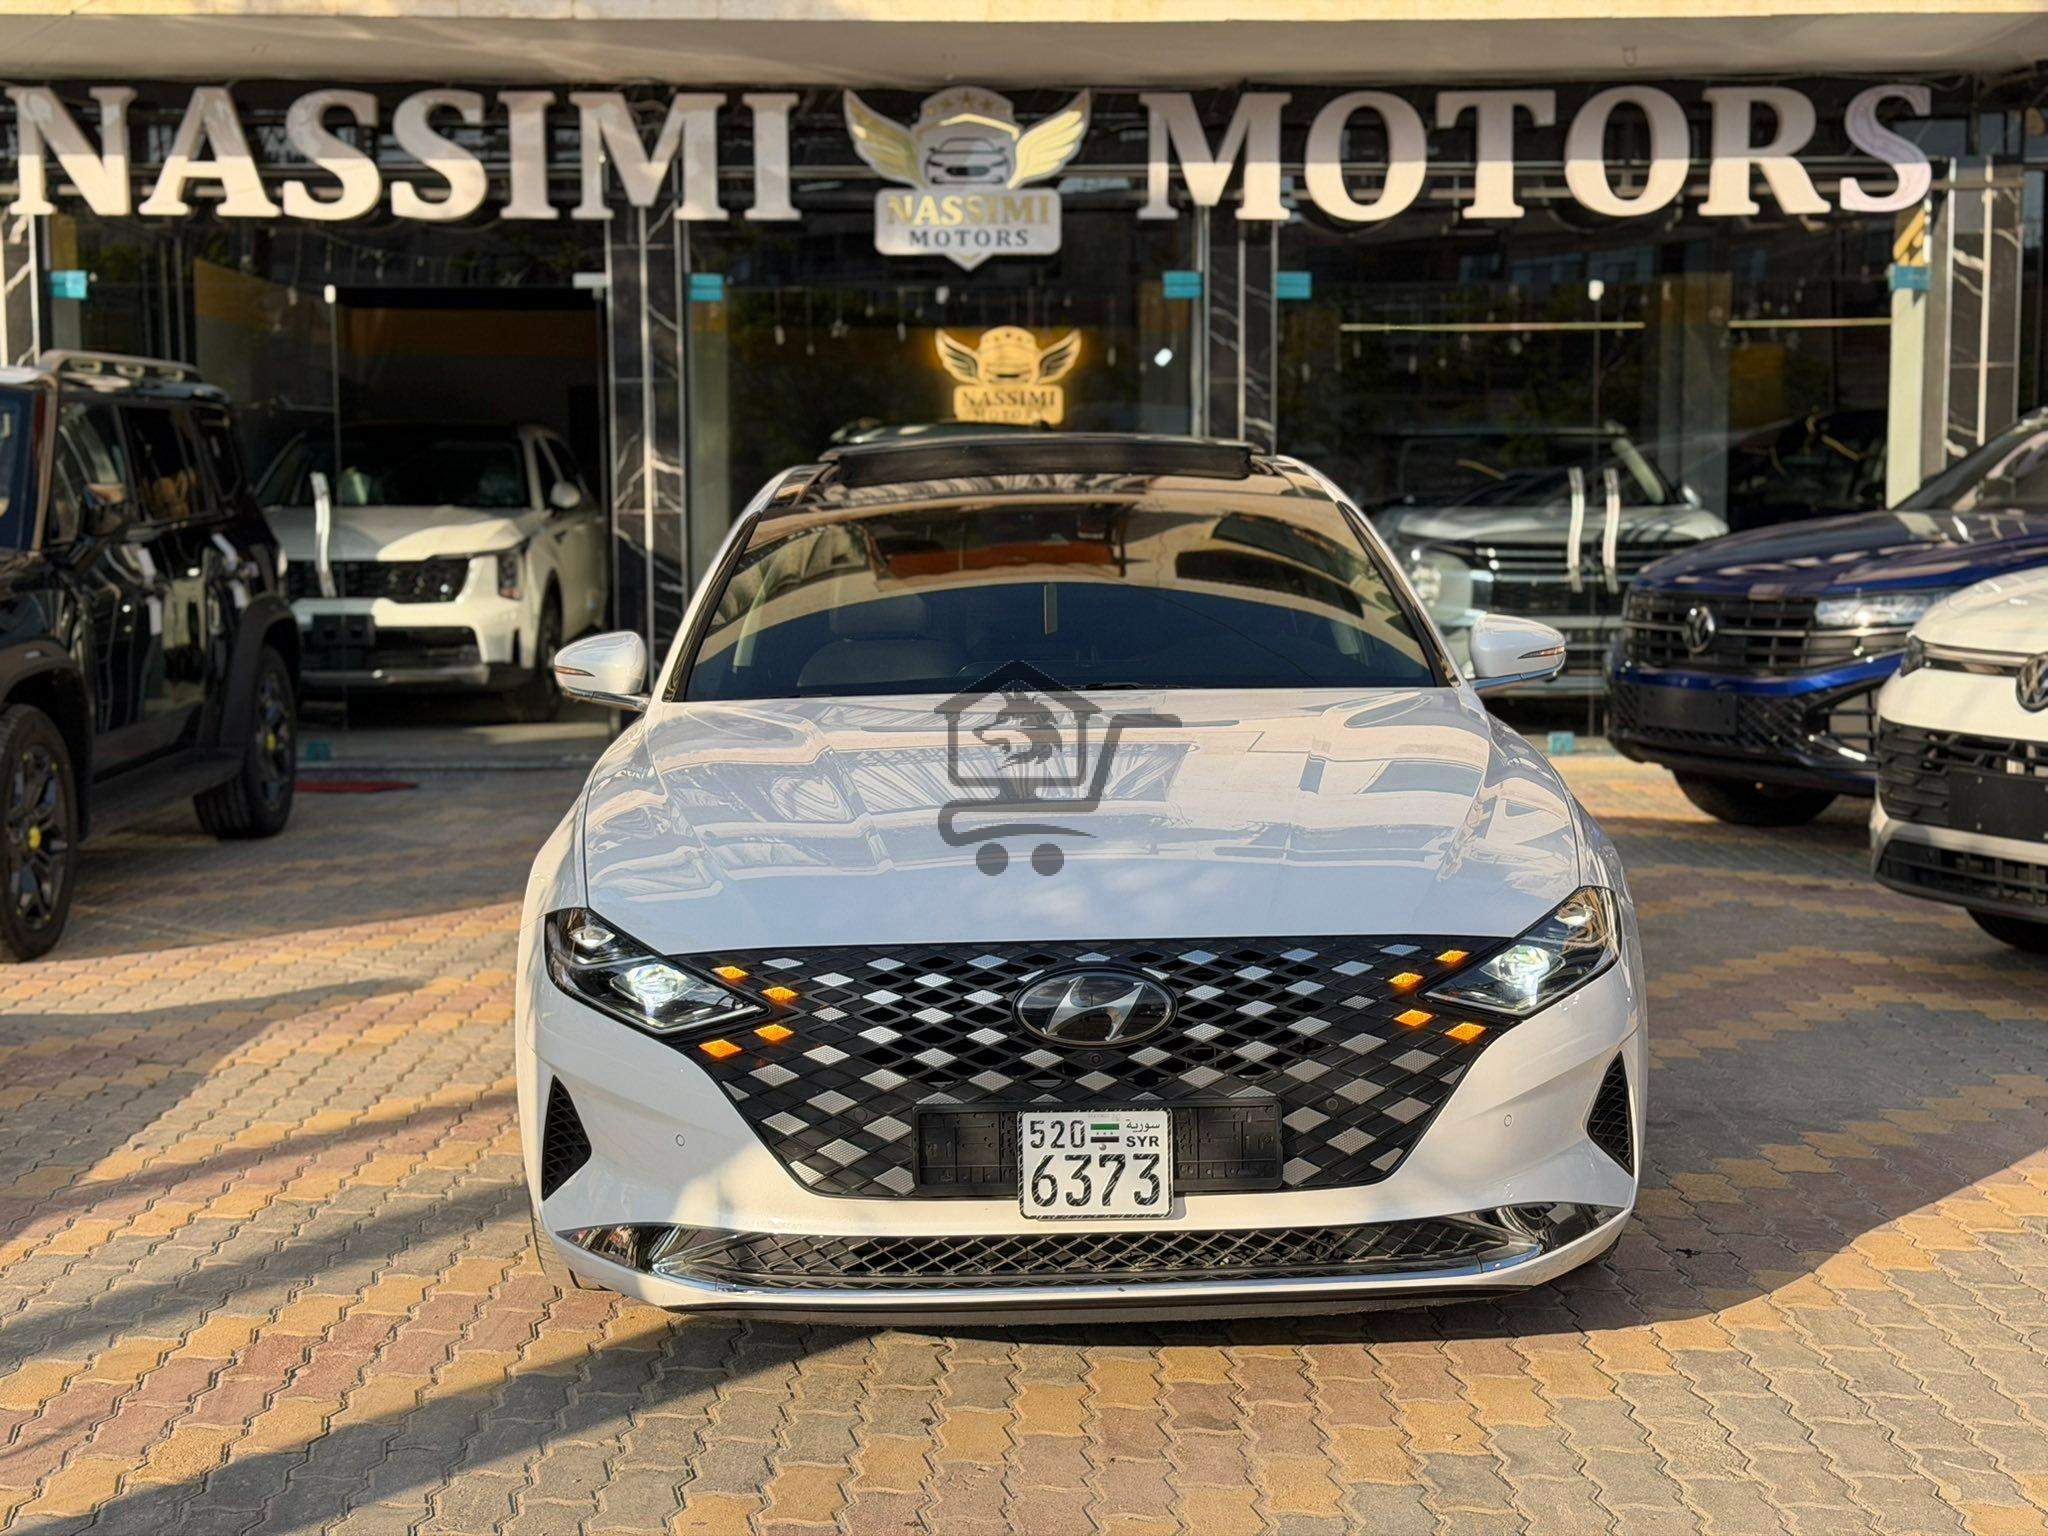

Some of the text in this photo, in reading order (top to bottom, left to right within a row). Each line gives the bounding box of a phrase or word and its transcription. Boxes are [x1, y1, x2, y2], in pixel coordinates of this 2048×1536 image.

[4, 84, 1934, 223] NASSIMI MOTORS
[885, 194, 1052, 227] NASSIMI
[908, 228, 1030, 249] MOTORS
[962, 391, 1056, 407] NASSIMI
[1029, 1119, 1086, 1149] 520
[1125, 1118, 1161, 1134] سورية
[1126, 1135, 1160, 1148] SYR
[1031, 1153, 1161, 1207] 6373
